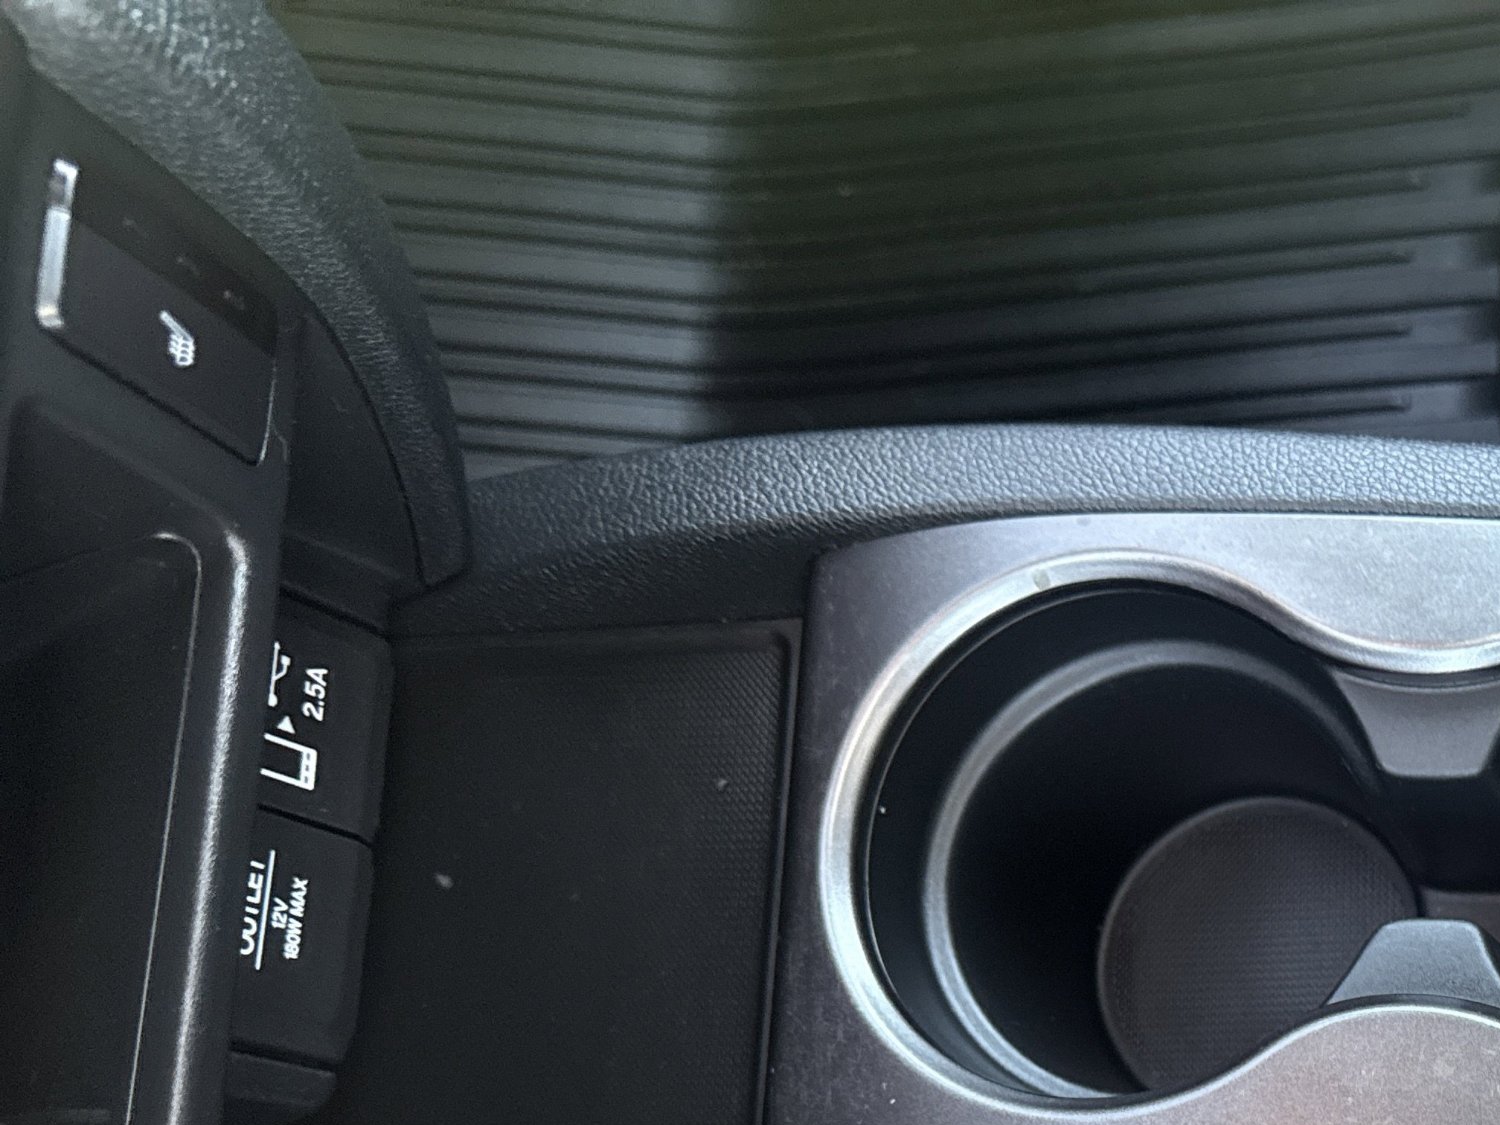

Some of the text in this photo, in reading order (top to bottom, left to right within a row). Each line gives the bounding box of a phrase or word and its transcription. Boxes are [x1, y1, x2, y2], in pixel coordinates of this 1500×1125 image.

[302, 667, 329, 722] 2.5A
[270, 896, 289, 930] 12V
[283, 876, 309, 960] 180W MAX
